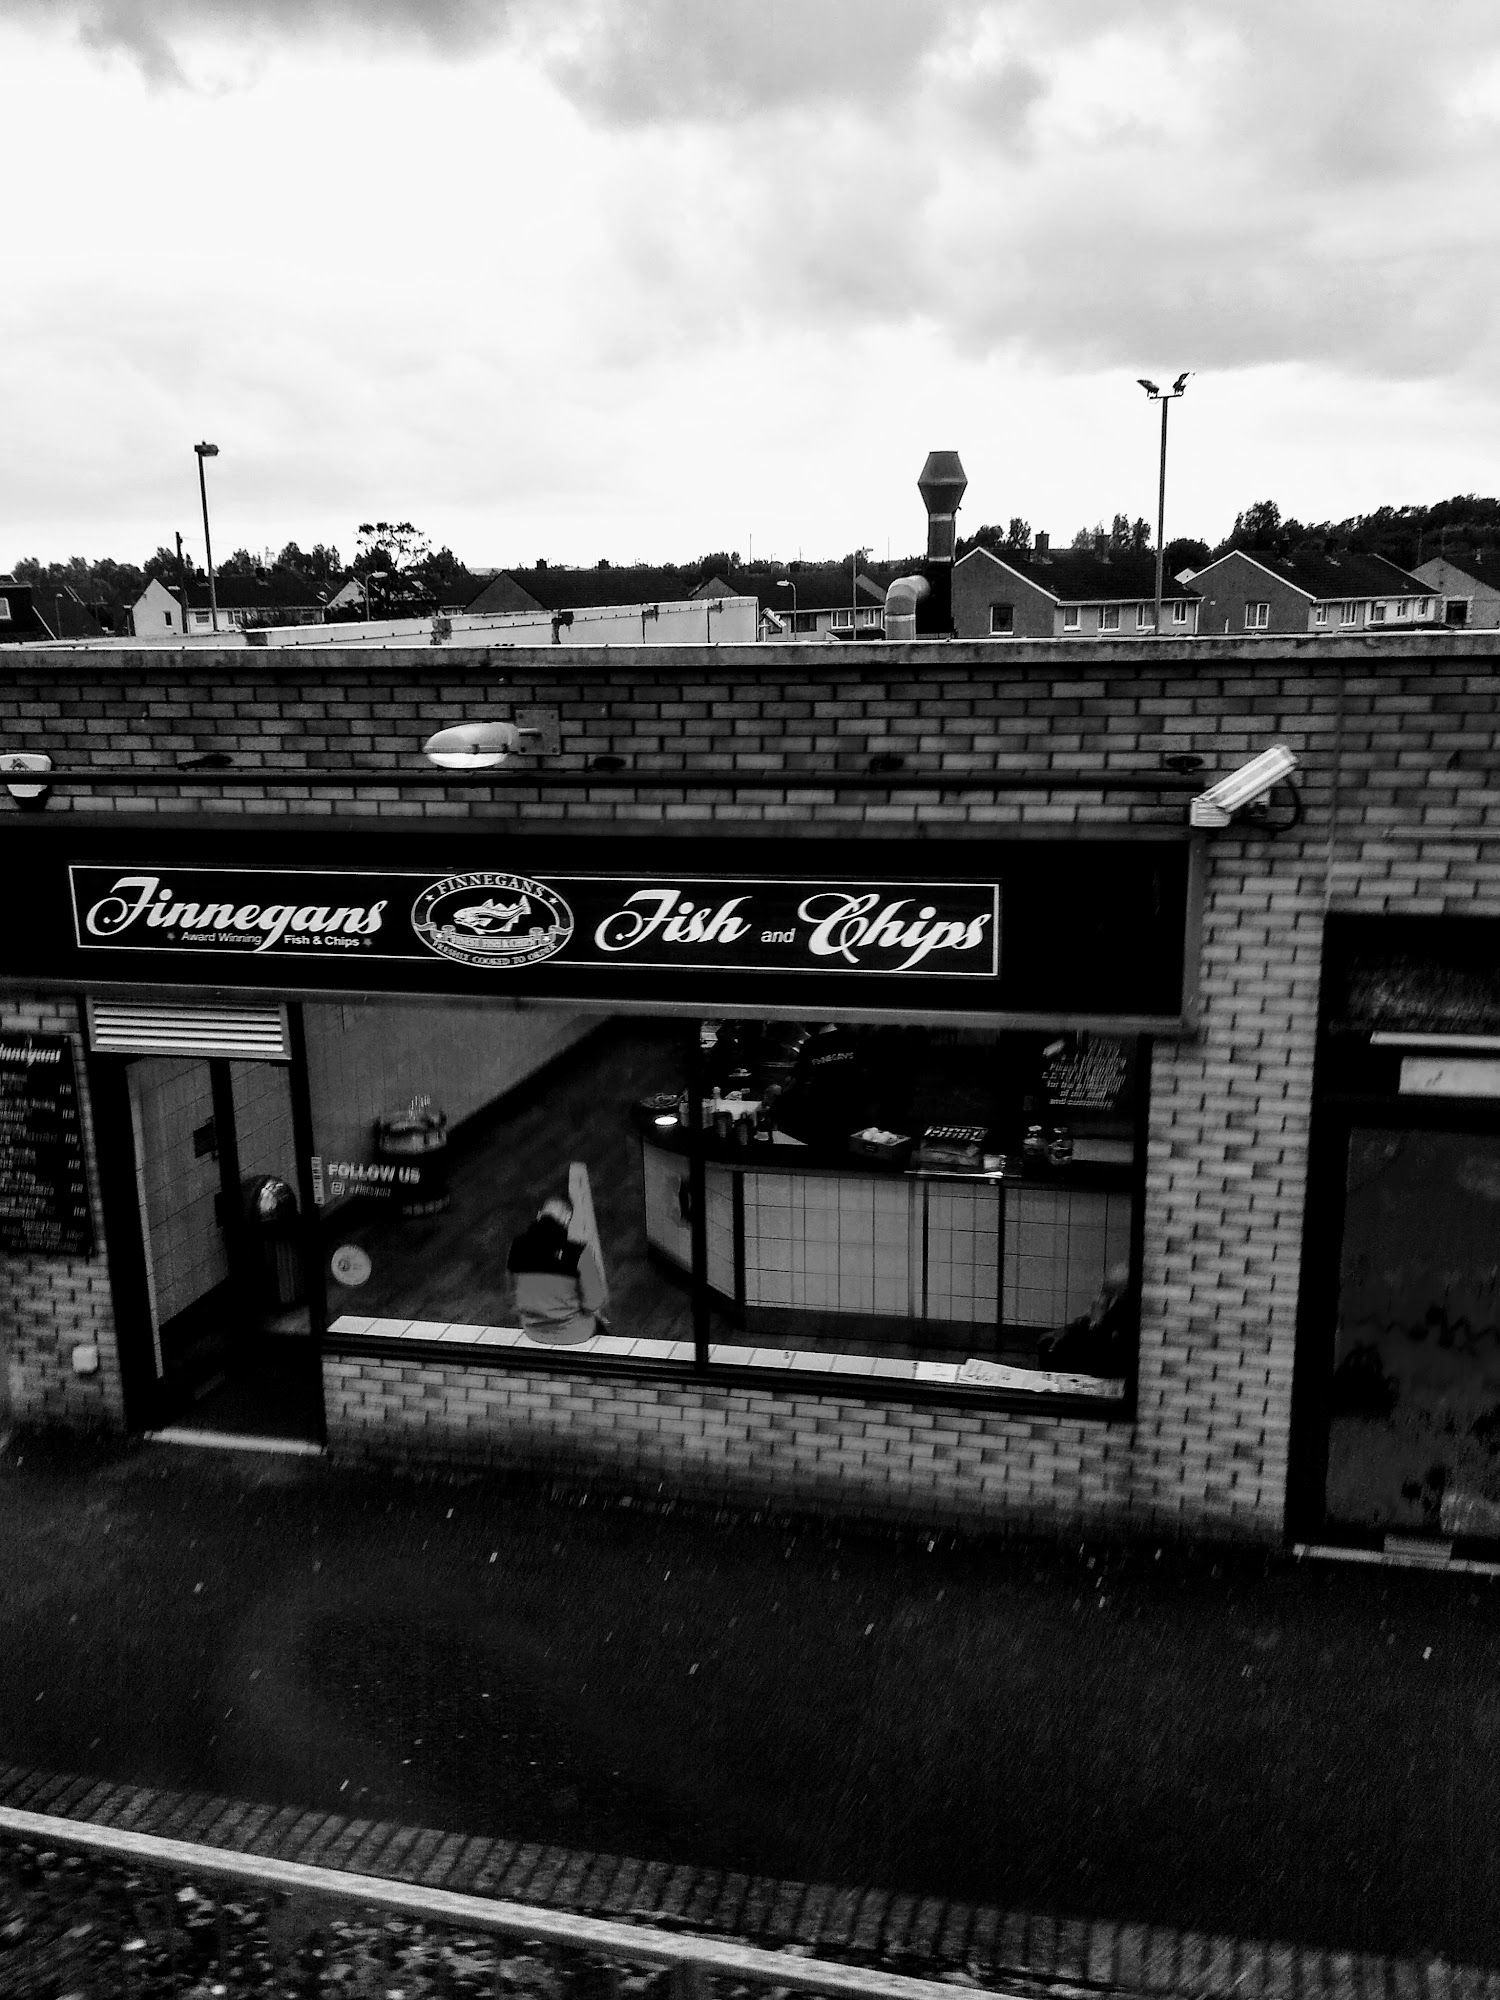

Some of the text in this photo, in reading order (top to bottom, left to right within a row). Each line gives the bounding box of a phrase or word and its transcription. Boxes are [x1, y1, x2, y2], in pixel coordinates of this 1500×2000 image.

[437, 874, 545, 896] FINNEGANS
[86, 877, 388, 952] Finnegans
[181, 932, 359, 947] Award Winning Fish & Chips
[595, 889, 992, 972] Fish and Chips
[513, 956, 526, 965] TO
[328, 1162, 396, 1182] FOLLOW
